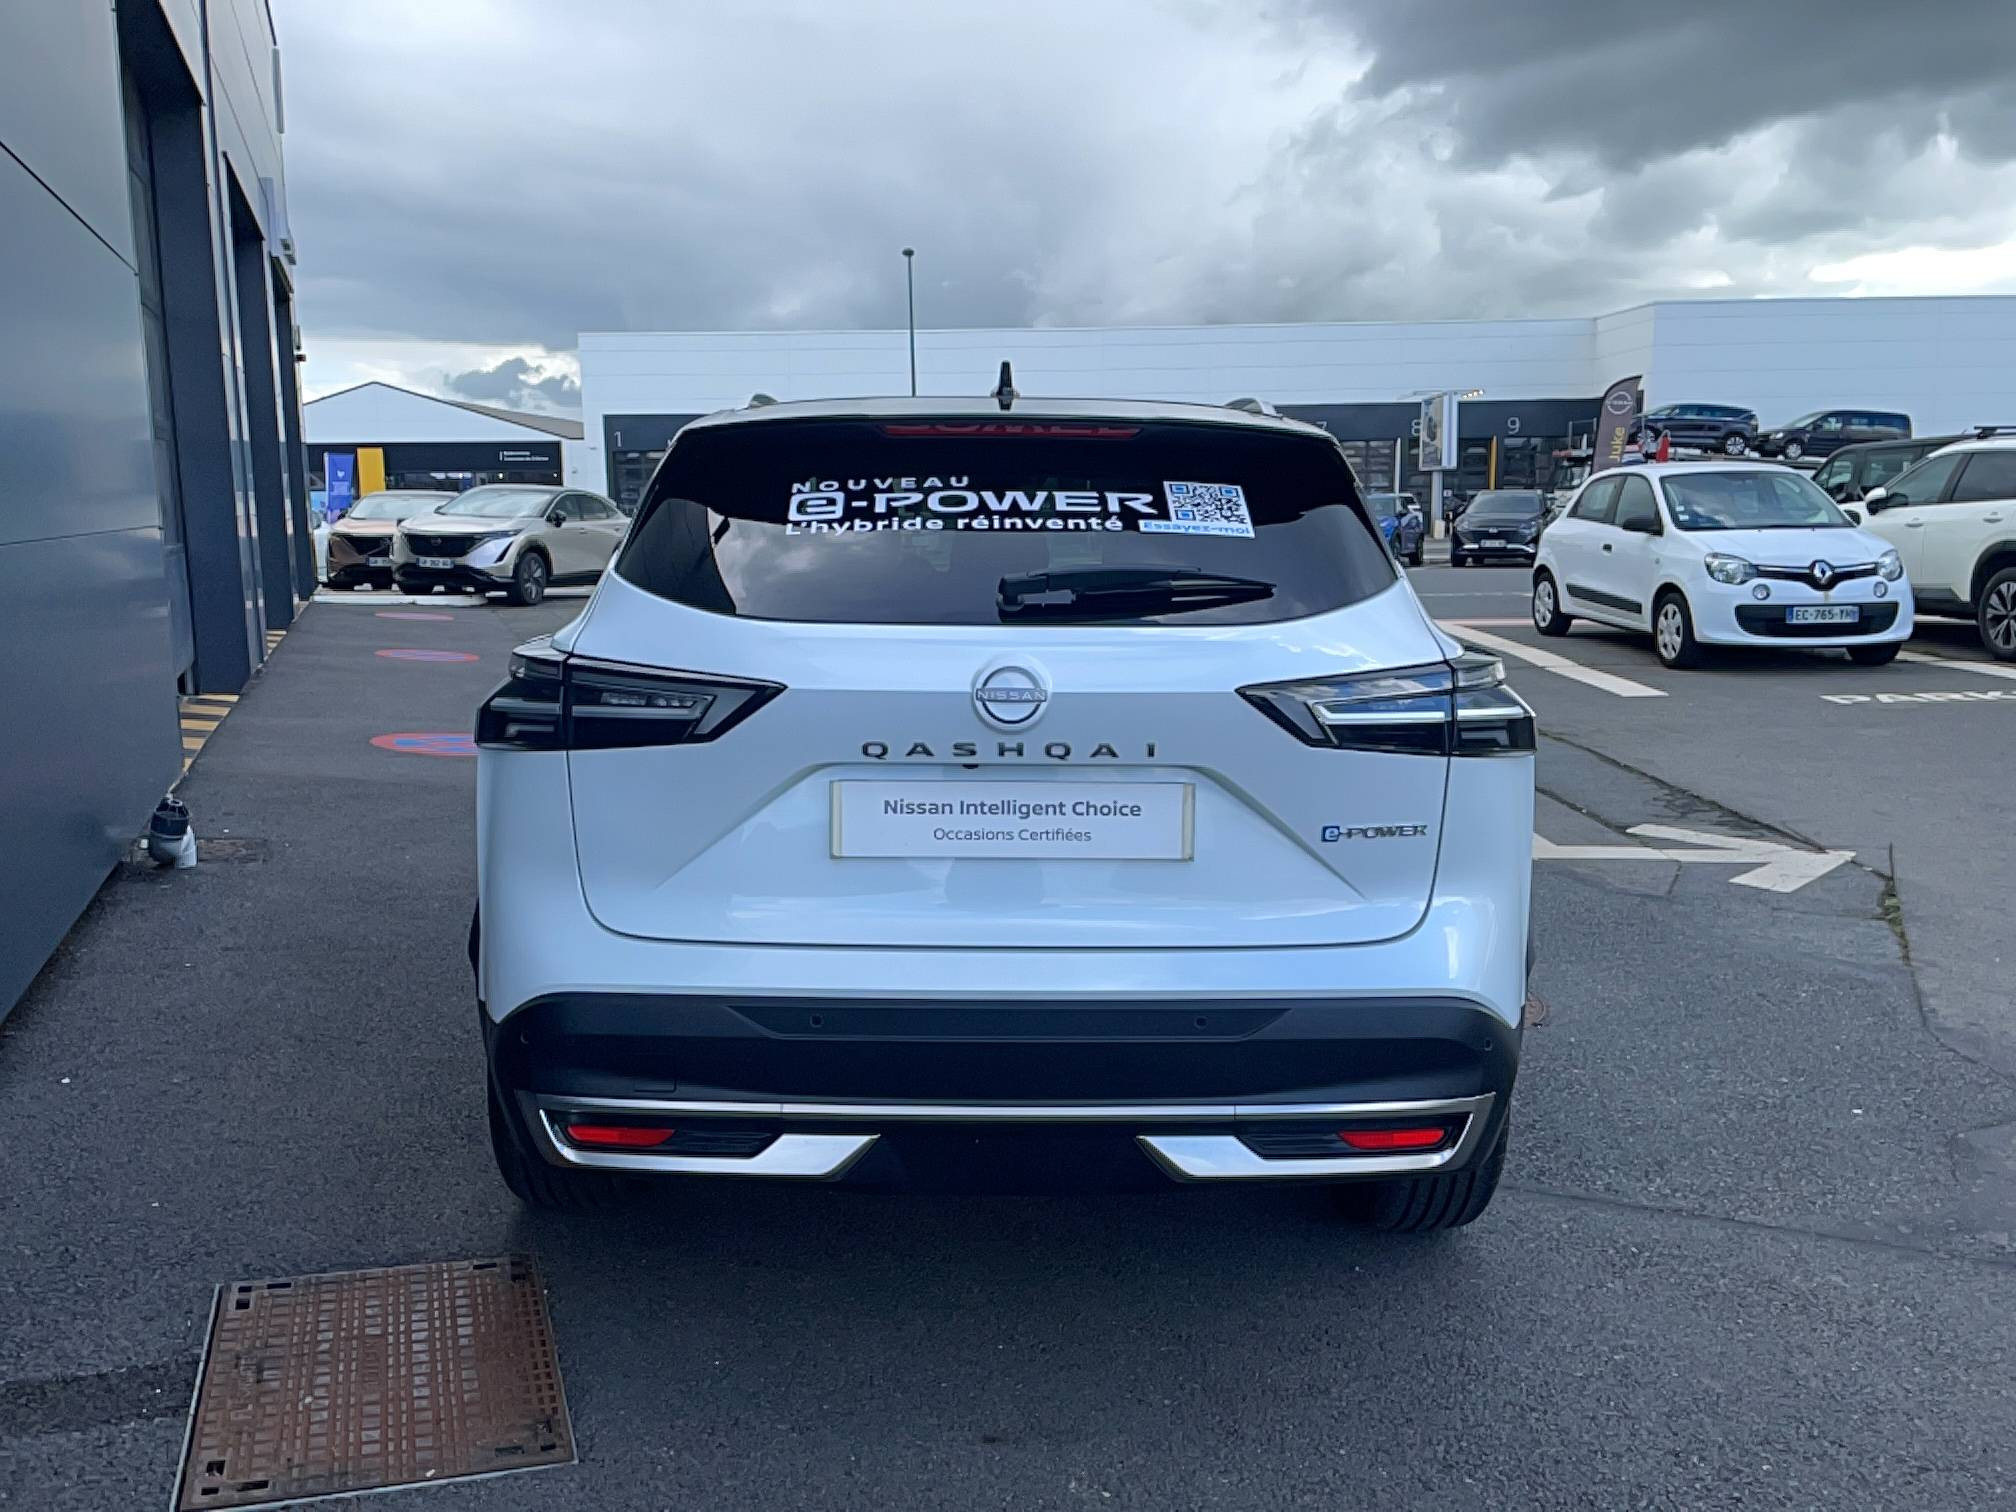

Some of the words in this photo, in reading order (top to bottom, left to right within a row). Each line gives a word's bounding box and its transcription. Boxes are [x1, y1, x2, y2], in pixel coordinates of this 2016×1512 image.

[1507, 416, 1521, 435] 9
[613, 431, 622, 448] 1
[1608, 426, 1625, 462] Juke
[791, 475, 969, 493] NOUVEAU
[787, 490, 1159, 522] e-POWER
[785, 516, 944, 536] L'hybride
[956, 515, 1124, 531] réinventé
[977, 689, 1046, 701] NISSAN
[861, 741, 1156, 760] QASHQAI
[883, 798, 953, 816] Nissan
[959, 799, 1067, 819] Intelligent
[1071, 800, 1142, 817] Choice
[933, 827, 1014, 841] Occasions
[1017, 827, 1092, 842] Certifiées
[1321, 825, 1428, 843] e-POWER
